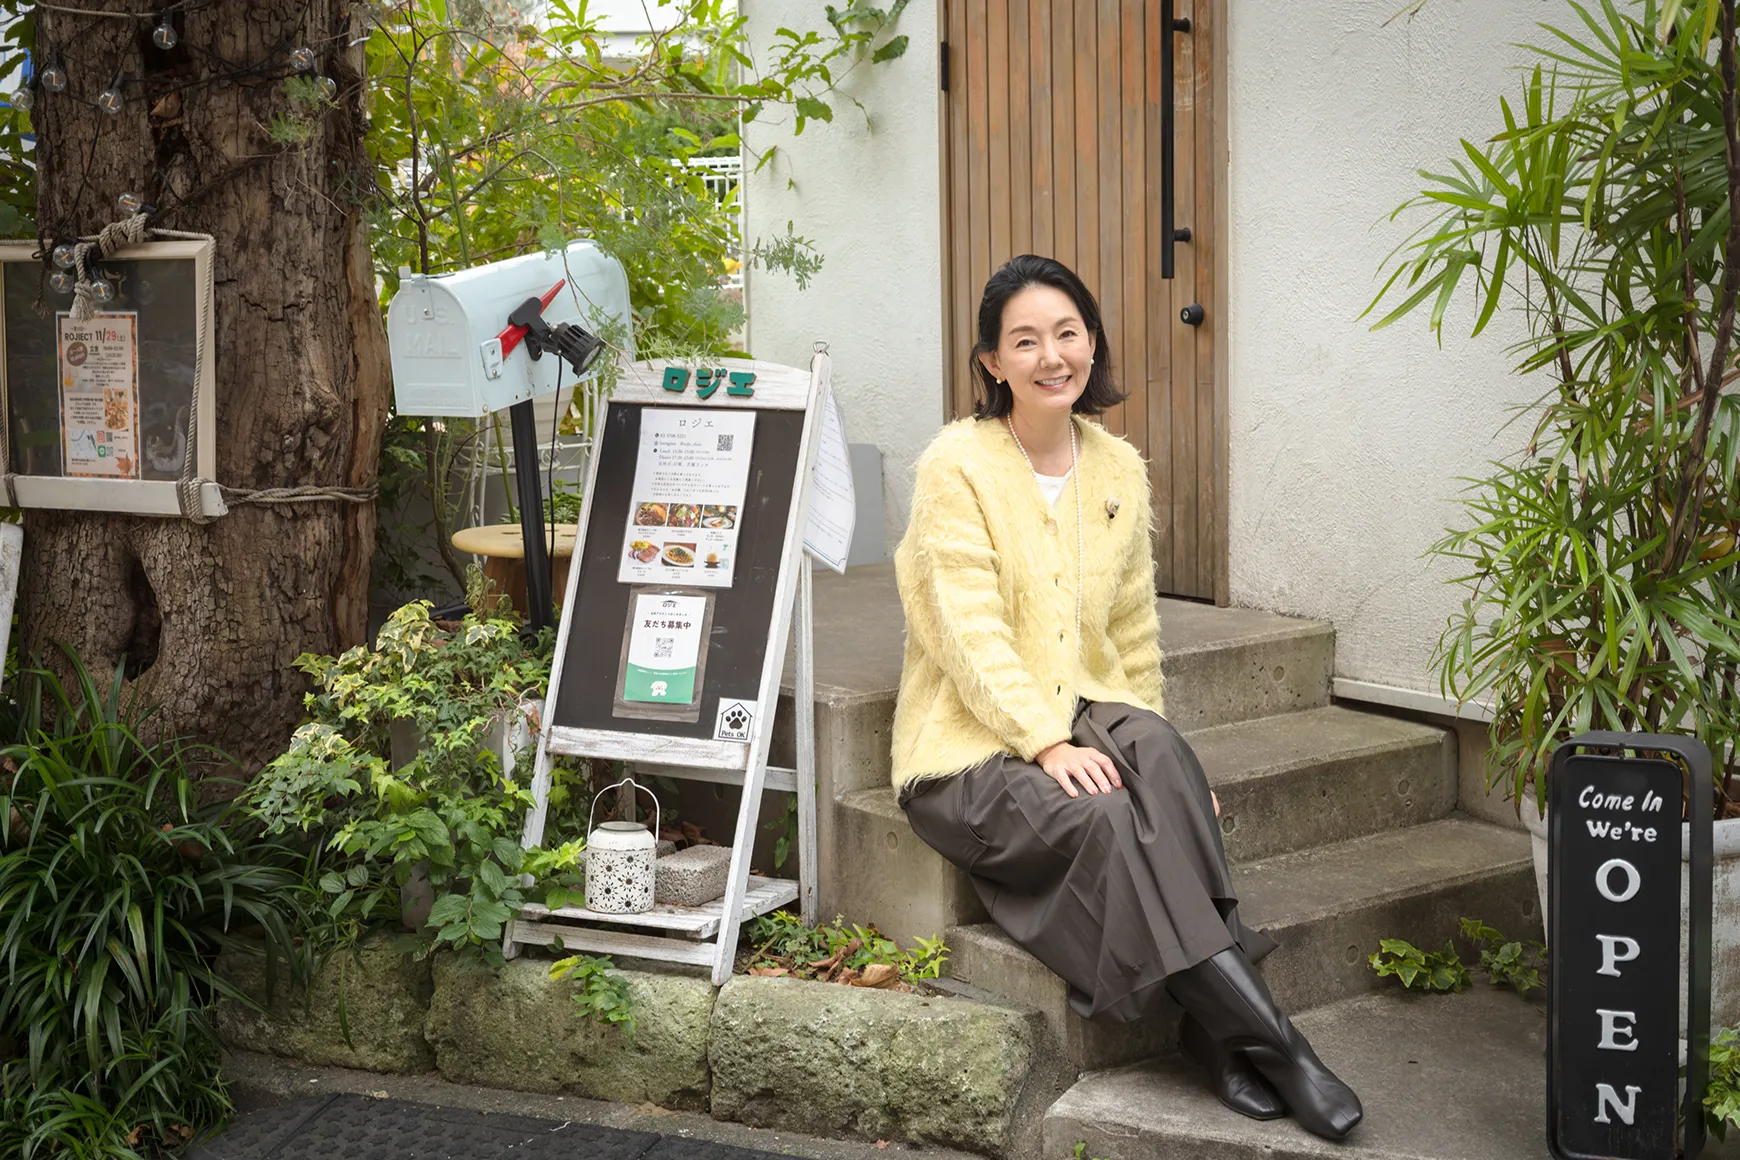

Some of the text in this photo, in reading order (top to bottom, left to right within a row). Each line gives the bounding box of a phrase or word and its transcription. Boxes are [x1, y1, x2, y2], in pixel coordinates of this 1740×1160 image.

[404, 332, 460, 355] MAIL
[643, 619, 692, 630] 友だち募集中
[1579, 785, 1663, 812] Come In
[1586, 820, 1658, 842] We're
[1594, 858, 1642, 1126] OPEN
